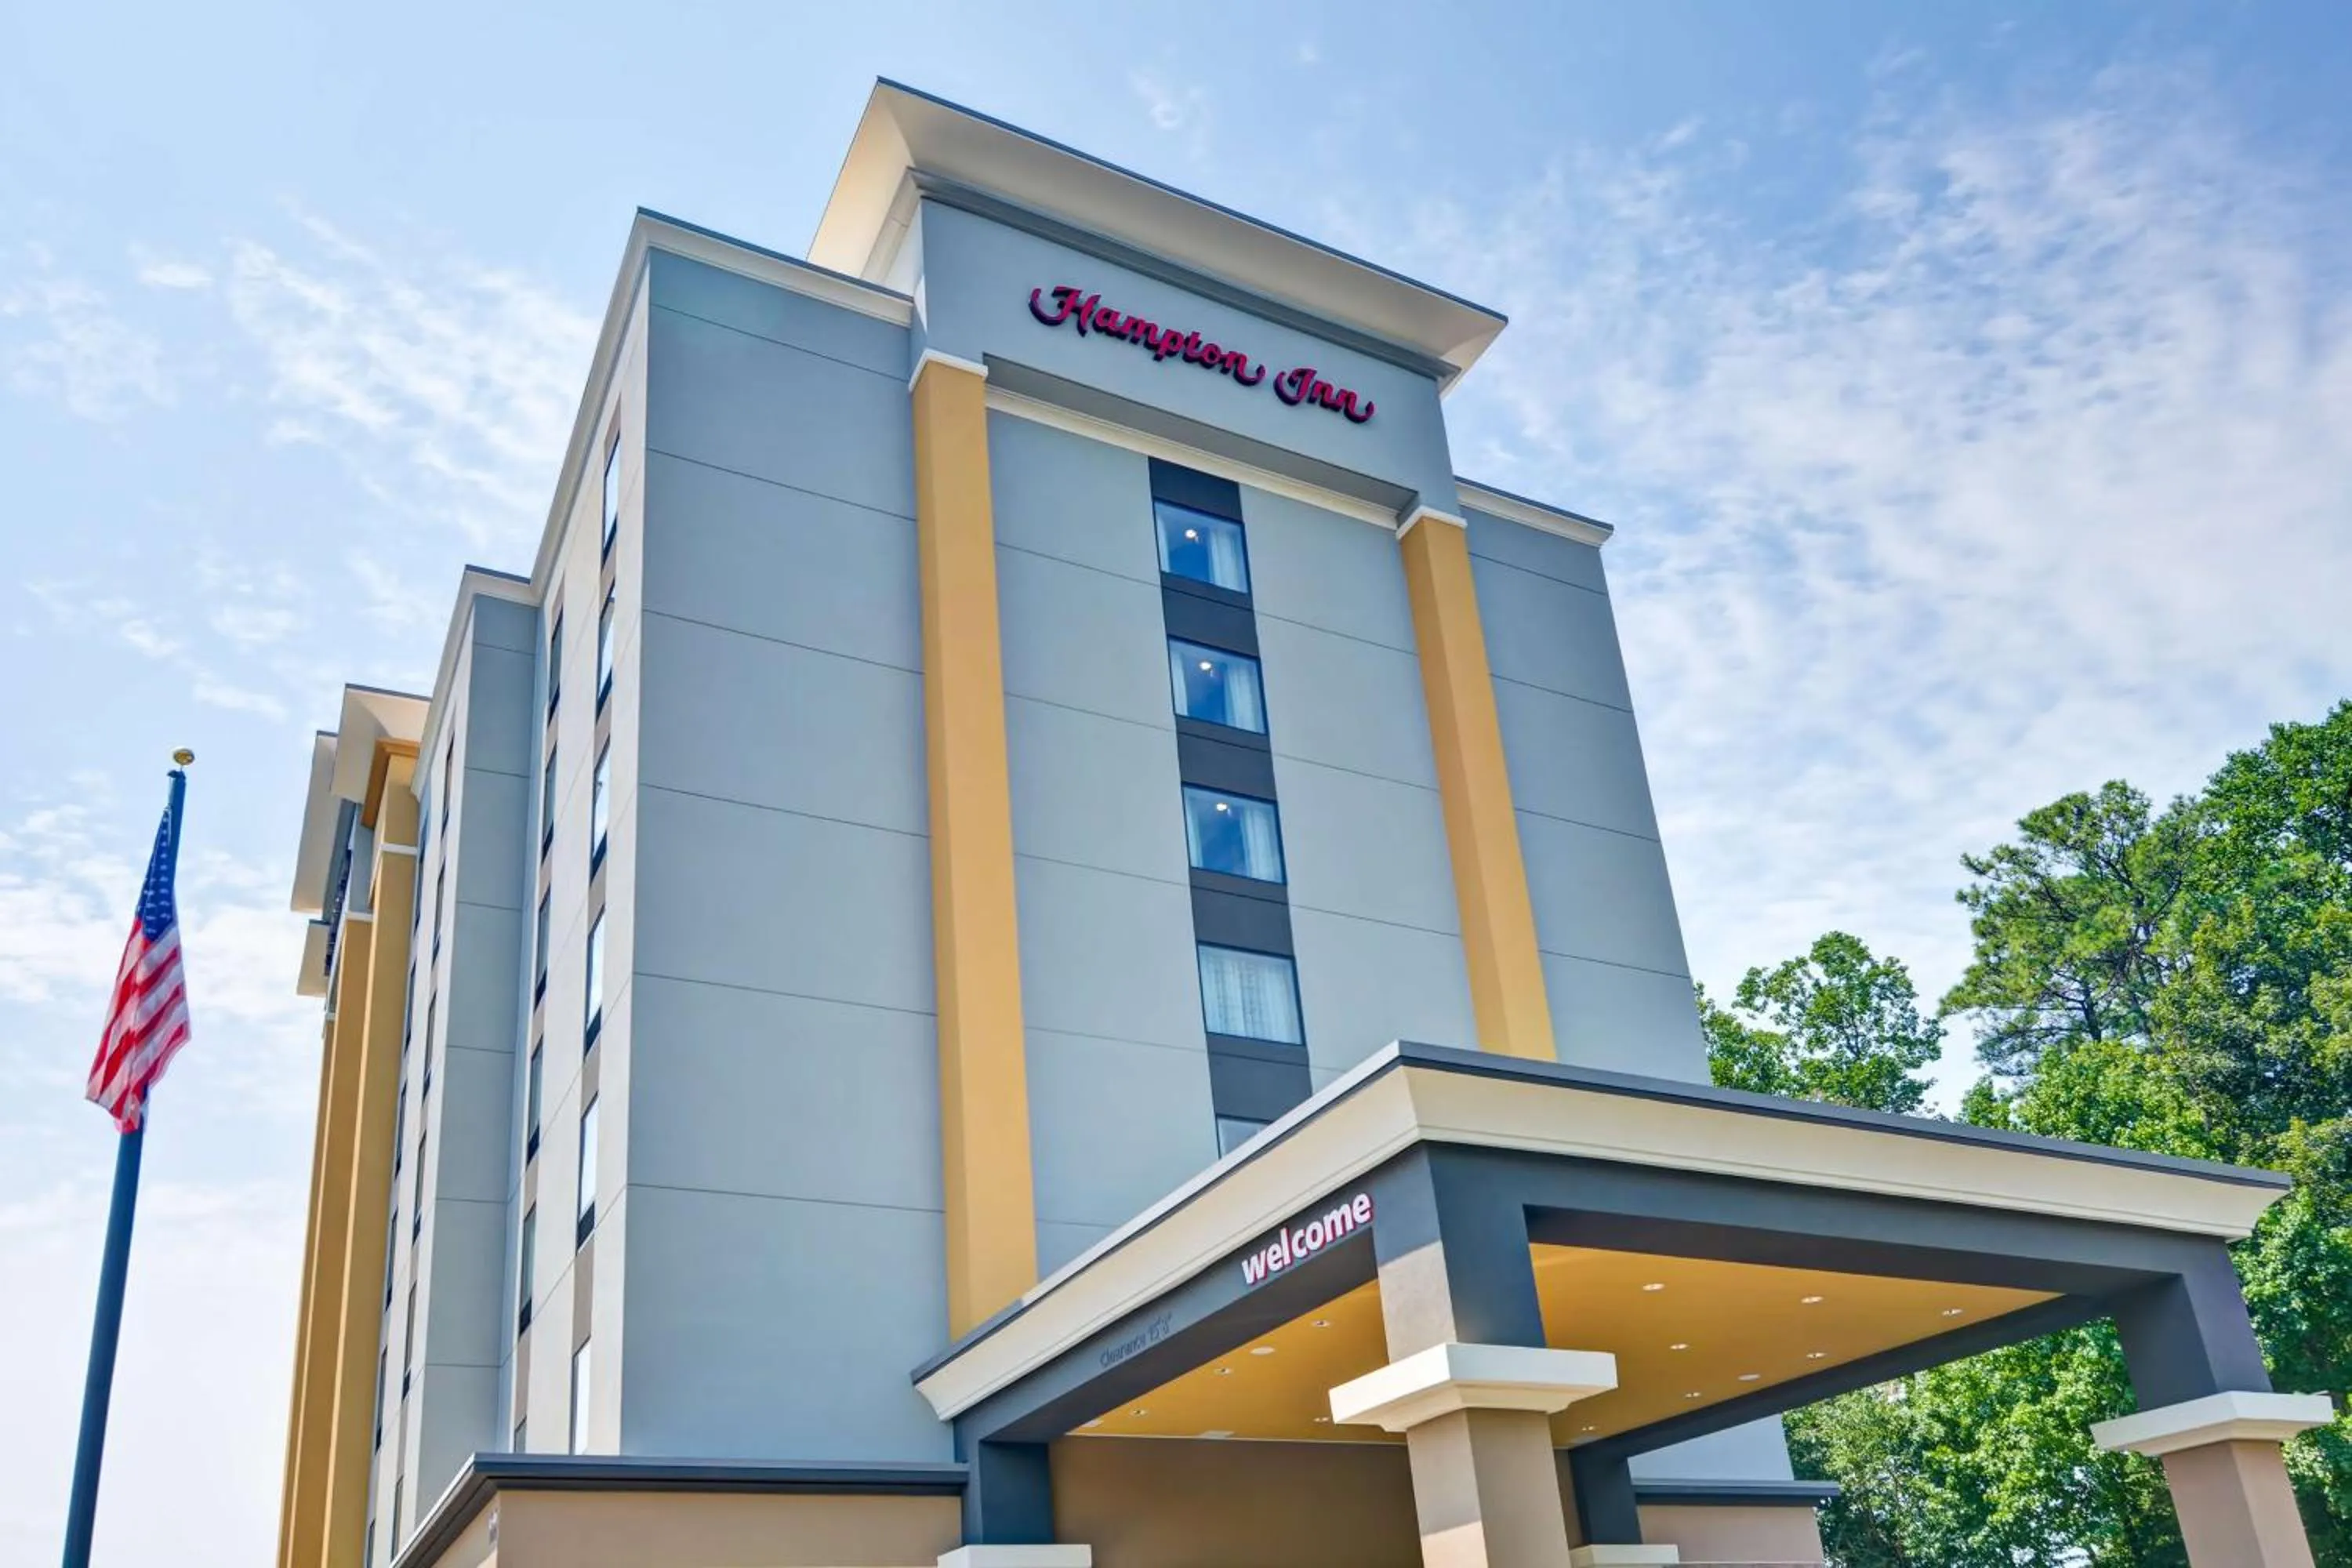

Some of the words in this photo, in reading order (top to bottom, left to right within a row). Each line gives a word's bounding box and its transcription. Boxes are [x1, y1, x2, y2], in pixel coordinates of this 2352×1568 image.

[1029, 285, 1266, 387] Hampton
[1273, 367, 1374, 424] Inn
[1241, 1192, 1374, 1286] welcome
[1099, 1332, 1146, 1368] Clearance
